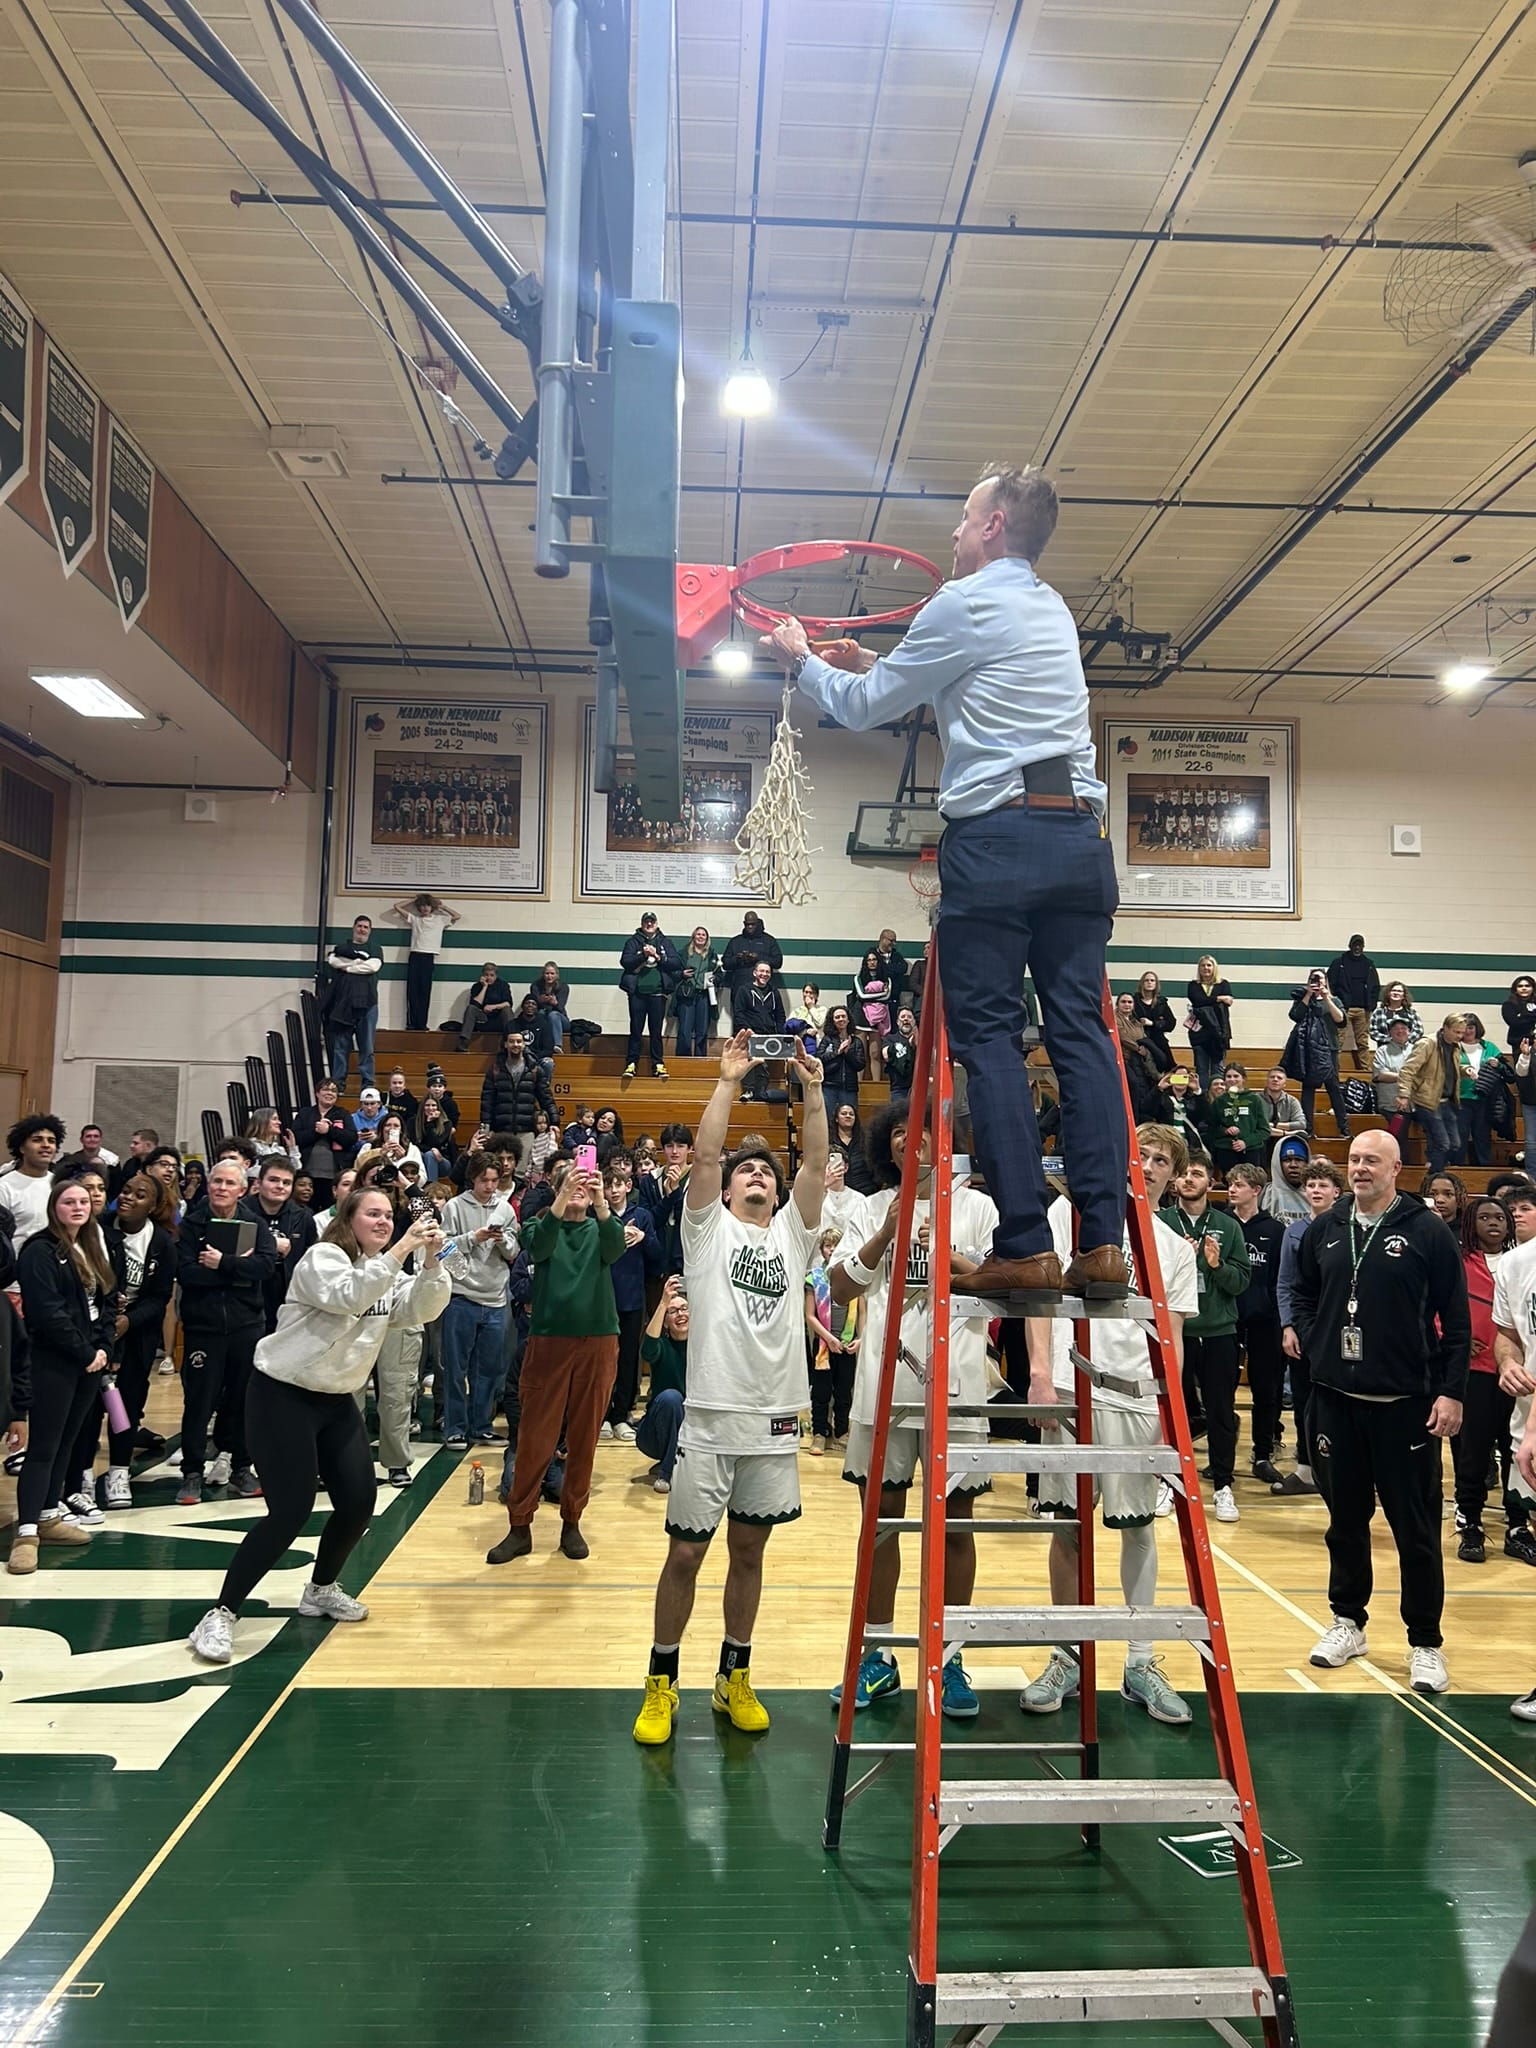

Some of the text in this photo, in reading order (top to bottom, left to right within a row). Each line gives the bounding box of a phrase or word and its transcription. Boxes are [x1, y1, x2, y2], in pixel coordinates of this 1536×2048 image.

[396, 707, 502, 721] MADISON MEMORIAL
[400, 726, 421, 741] 2005
[423, 726, 448, 737] State
[450, 727, 498, 744] Champions
[1147, 729, 1248, 744] MADISON MEMORIAL
[434, 738, 464, 750] 24-2
[1151, 748, 1172, 763] 2011
[1174, 749, 1197, 758] State
[1199, 749, 1246, 765] Champions
[1185, 760, 1213, 772] 22-6
[554, 1083, 570, 1094] G9
[559, 1106, 565, 1116] 8
[1247, 1251, 1267, 1263] RIAL
